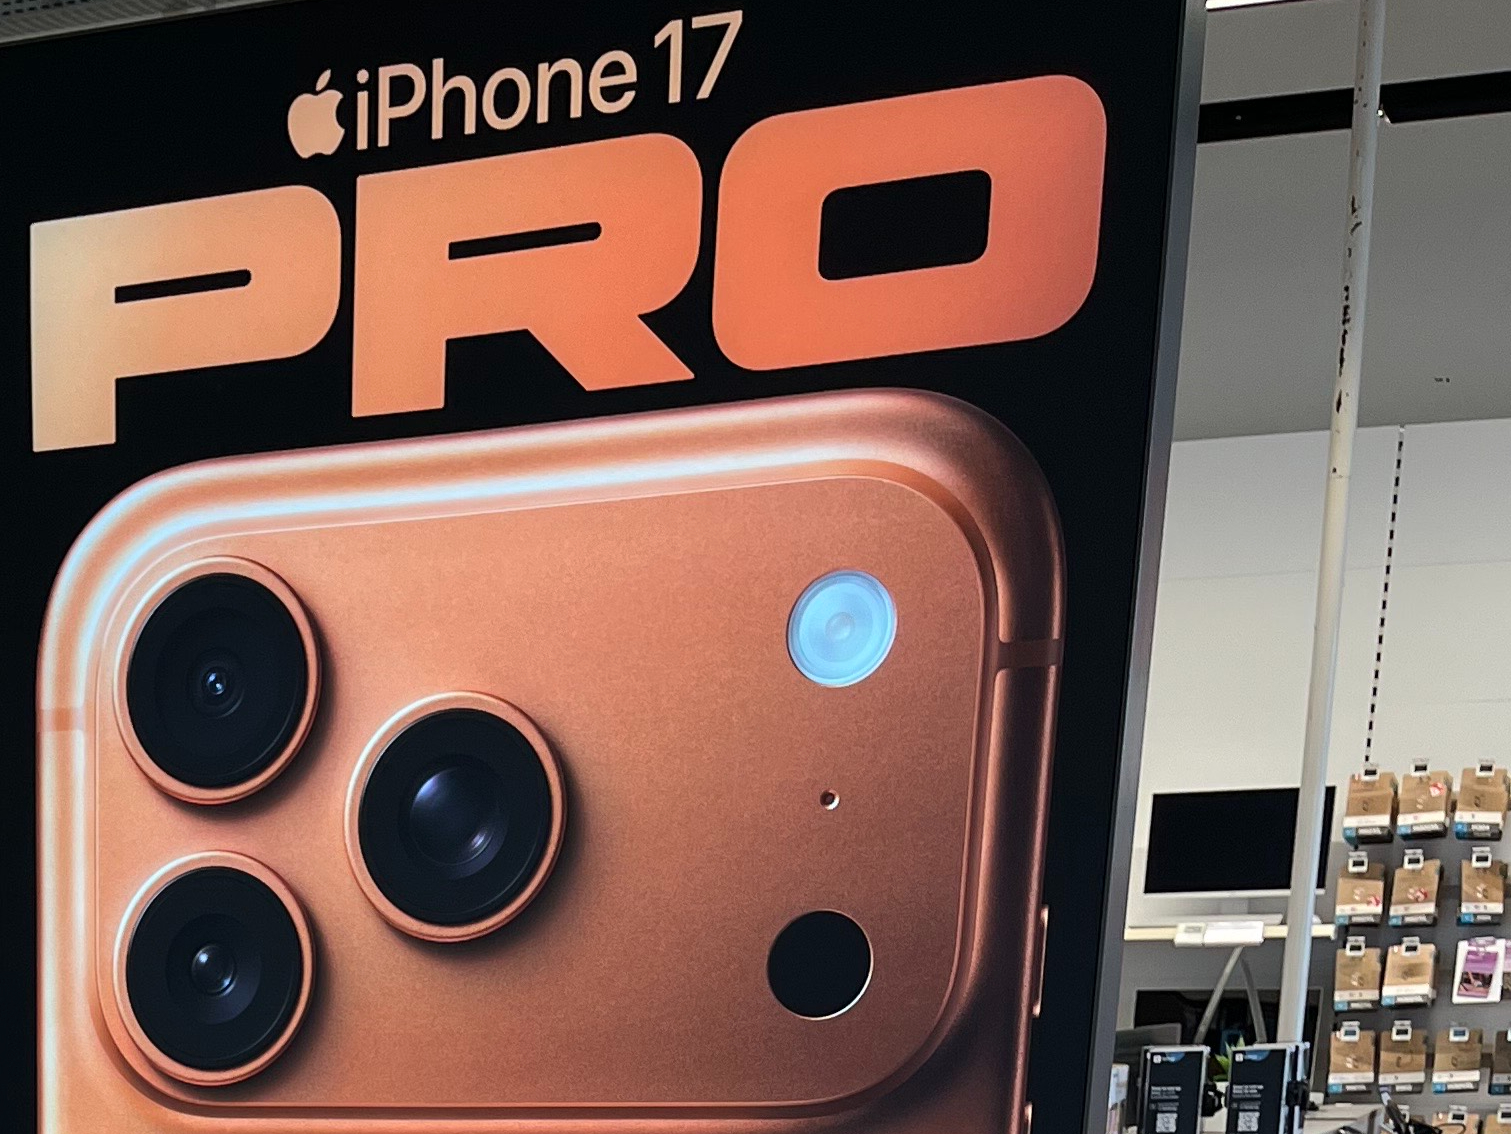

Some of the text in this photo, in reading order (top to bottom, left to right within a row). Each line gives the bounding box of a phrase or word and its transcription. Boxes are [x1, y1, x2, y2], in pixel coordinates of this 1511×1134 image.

[356, 9, 743, 151] iPhone 17
[29, 74, 1108, 453] PRO
